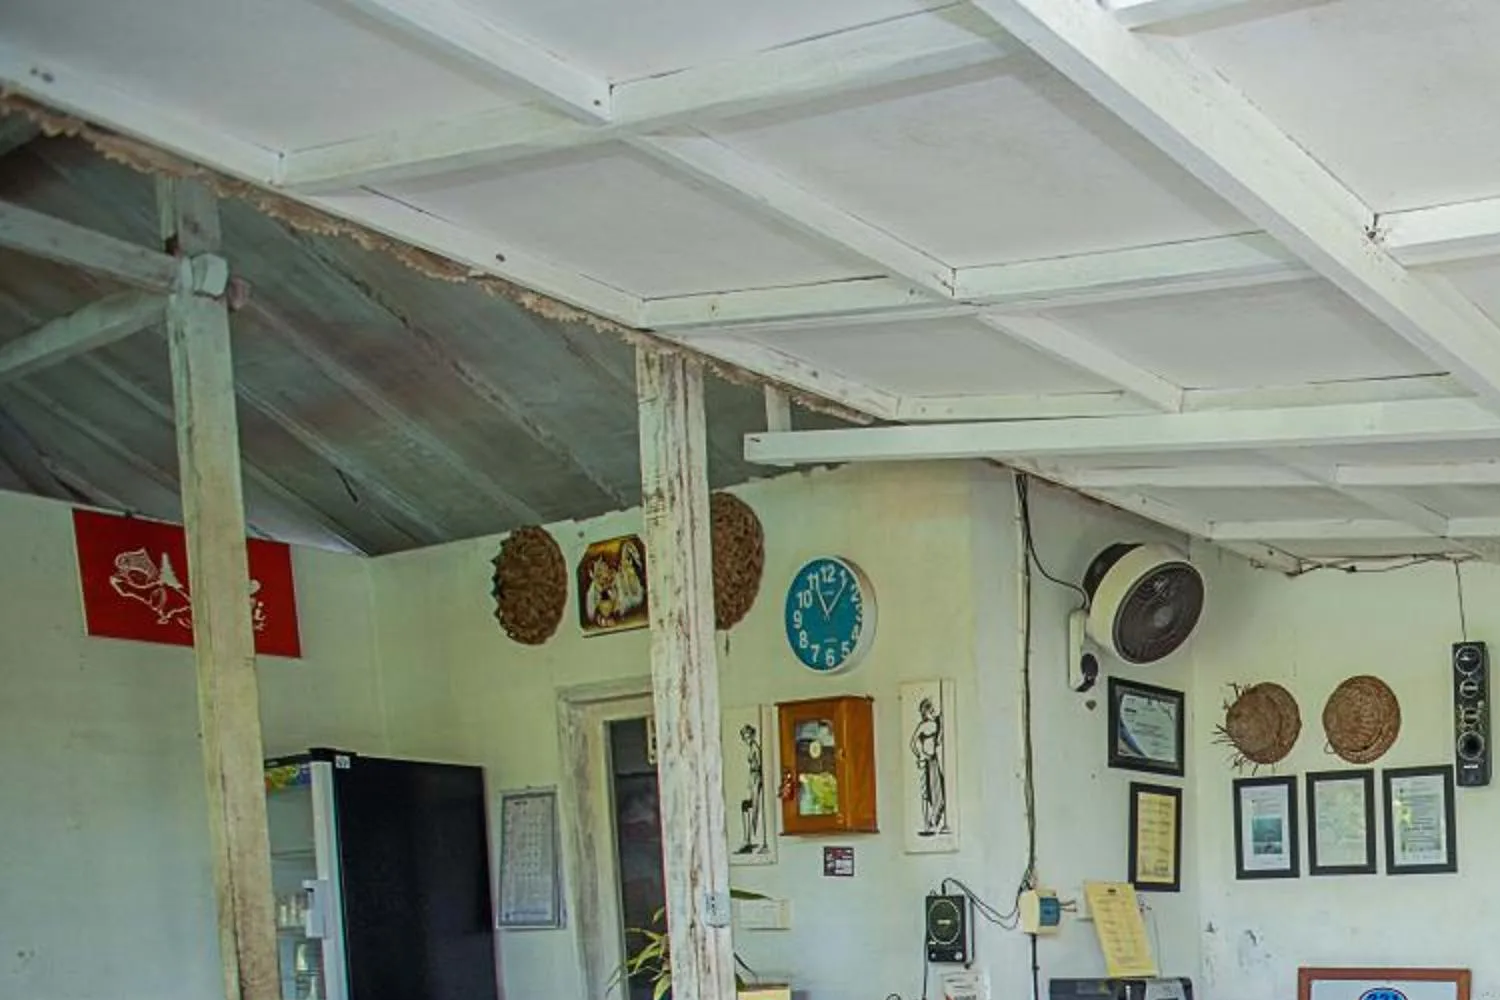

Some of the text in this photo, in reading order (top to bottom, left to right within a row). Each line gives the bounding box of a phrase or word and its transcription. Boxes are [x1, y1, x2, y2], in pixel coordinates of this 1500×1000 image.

[807, 571, 819, 591] 11
[820, 564, 836, 583] 12
[796, 590, 813, 609] 10
[850, 583, 860, 603] 2
[793, 610, 803, 629] 9
[855, 603, 863, 622] 3
[799, 630, 808, 649] 8
[851, 624, 861, 641] 4
[810, 644, 820, 663] 7
[825, 648, 835, 667] 6
[840, 641, 851, 660] 5
